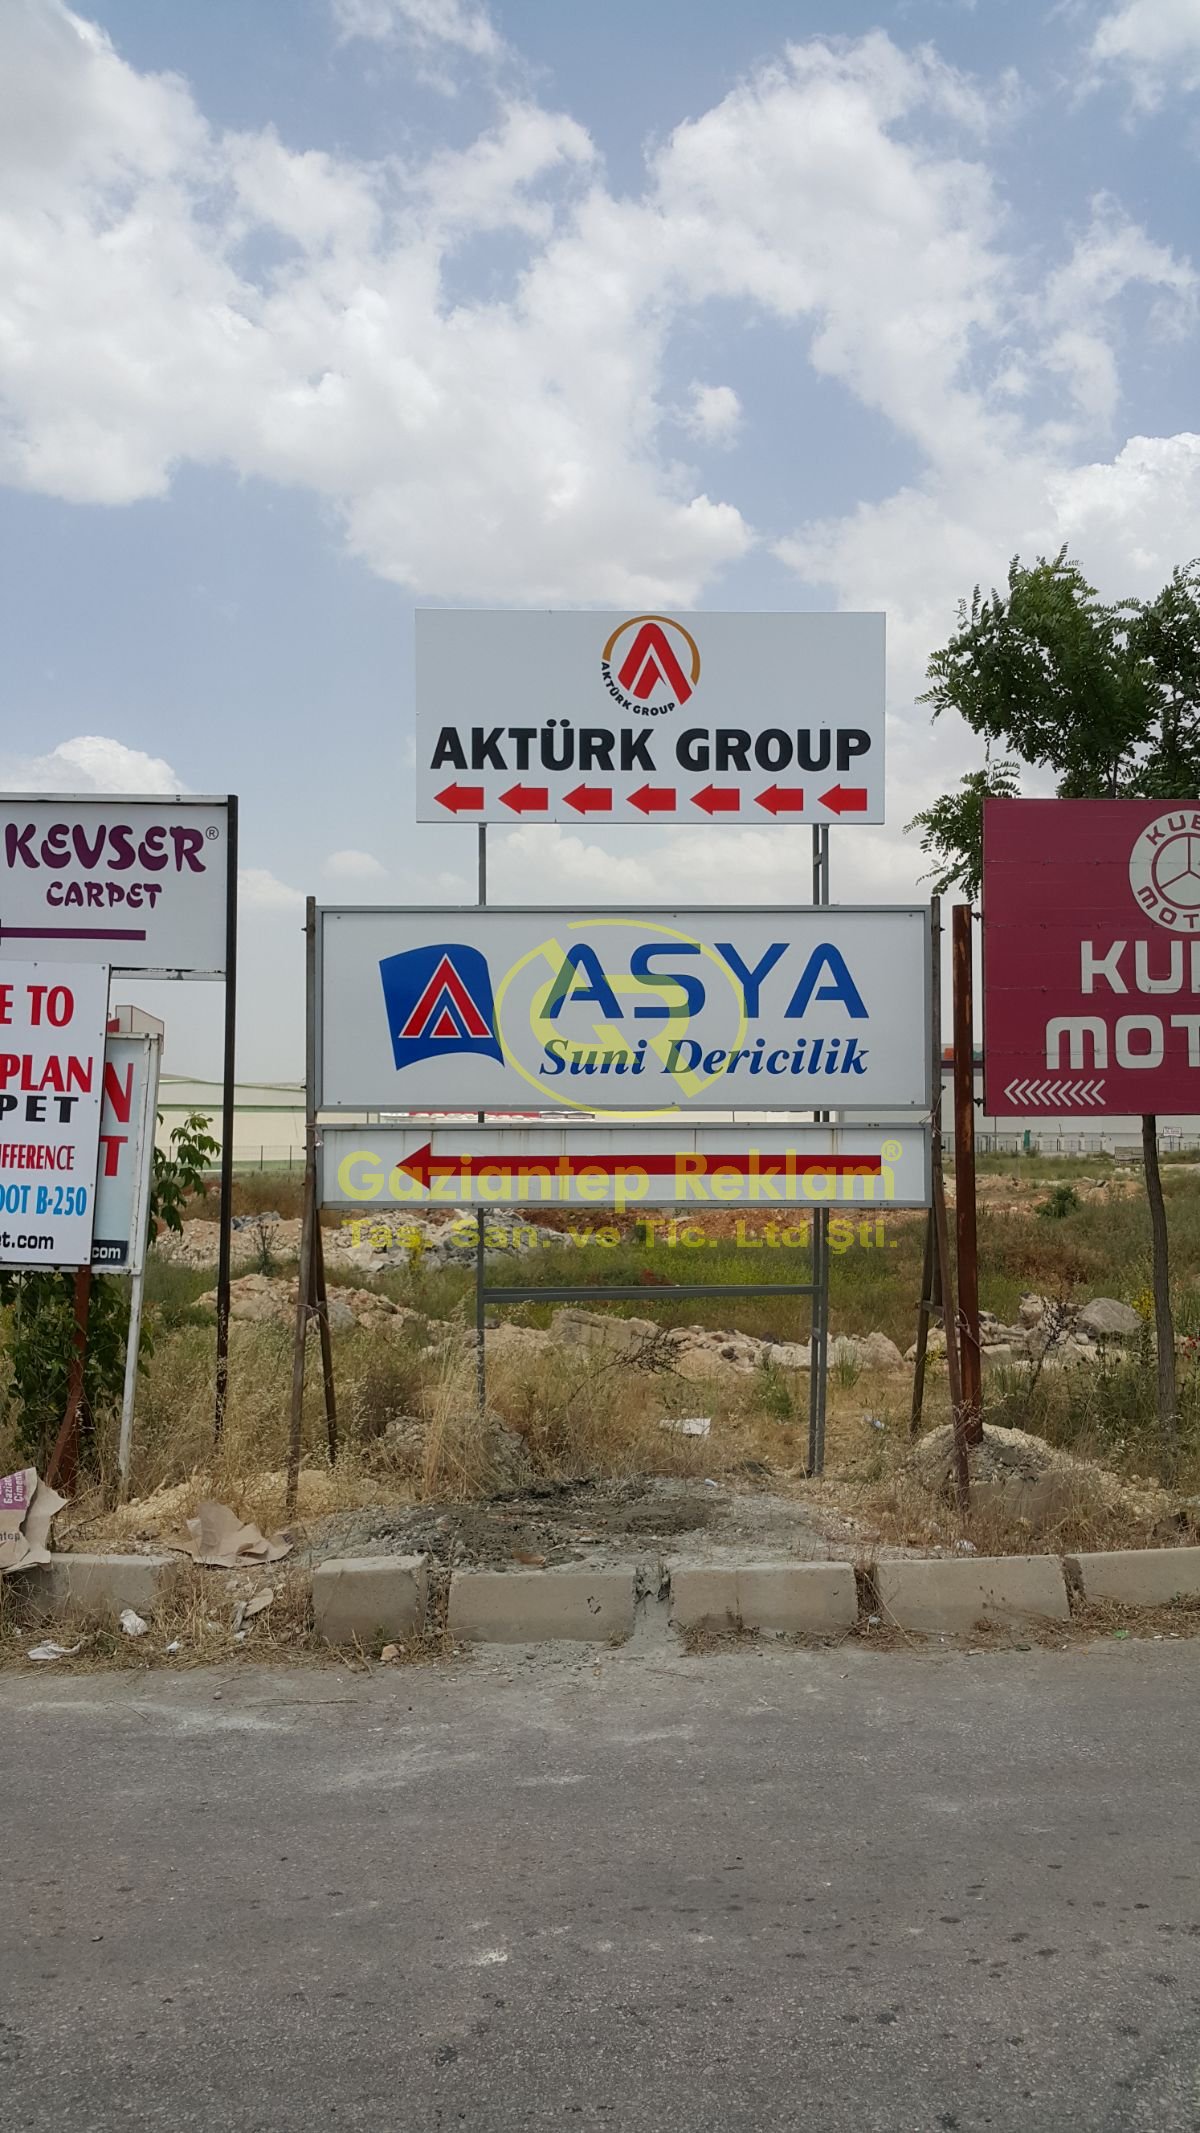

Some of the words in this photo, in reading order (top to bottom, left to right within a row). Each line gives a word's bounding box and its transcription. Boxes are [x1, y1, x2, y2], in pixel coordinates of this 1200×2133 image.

[601, 661, 632, 710] AKTÜRK
[632, 702, 676, 716] GROUP
[430, 718, 657, 771] AKTÜRK
[675, 728, 872, 772] GROUP
[46, 881, 162, 908] CARPET
[539, 942, 870, 1019] ASYA
[1081, 940, 1200, 994] KU
[27, 985, 75, 1027] TO
[539, 1039, 648, 1075] Suni
[660, 1038, 869, 1075] Dericilik
[36, 1186, 87, 1216] B-250
